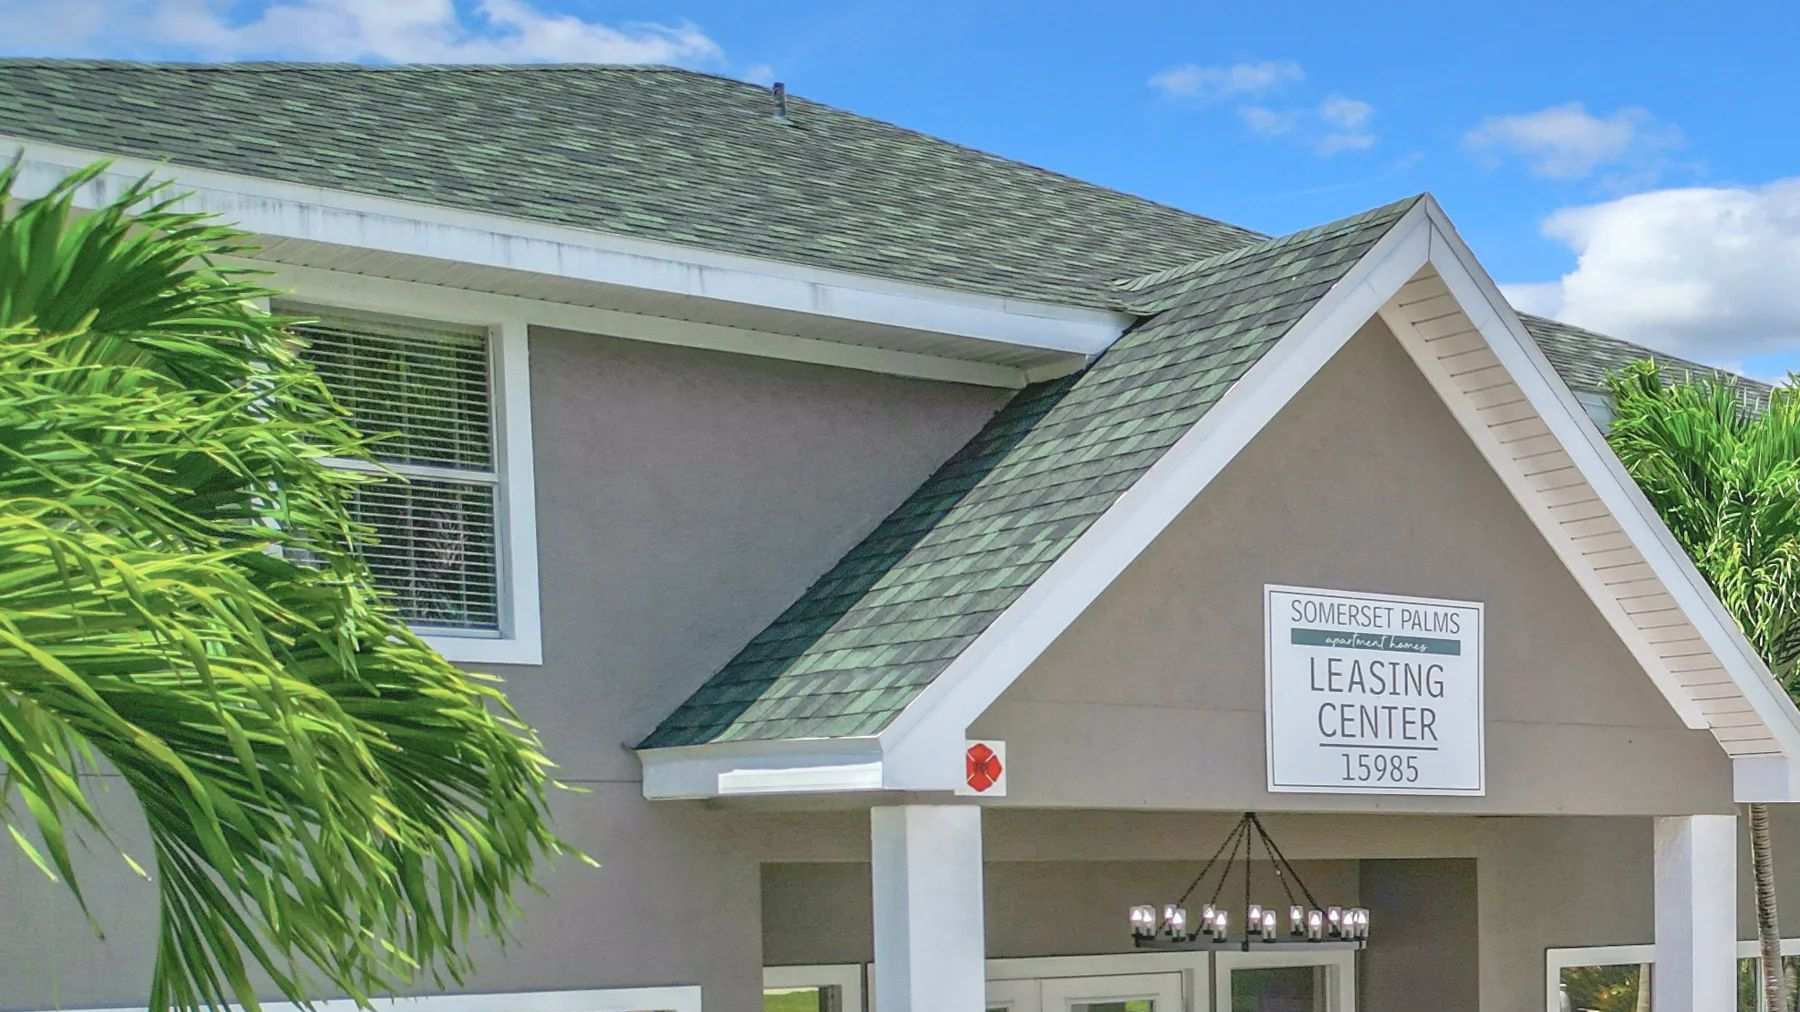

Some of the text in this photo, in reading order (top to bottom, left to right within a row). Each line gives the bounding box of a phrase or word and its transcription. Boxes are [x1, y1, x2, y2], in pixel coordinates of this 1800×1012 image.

[1291, 599, 1461, 634] SOMERSET PALMS
[1325, 632, 1428, 652] apartment homes
[1310, 656, 1444, 698] LEASING
[1318, 702, 1438, 741] CENTER
[1341, 753, 1419, 782] 15985
